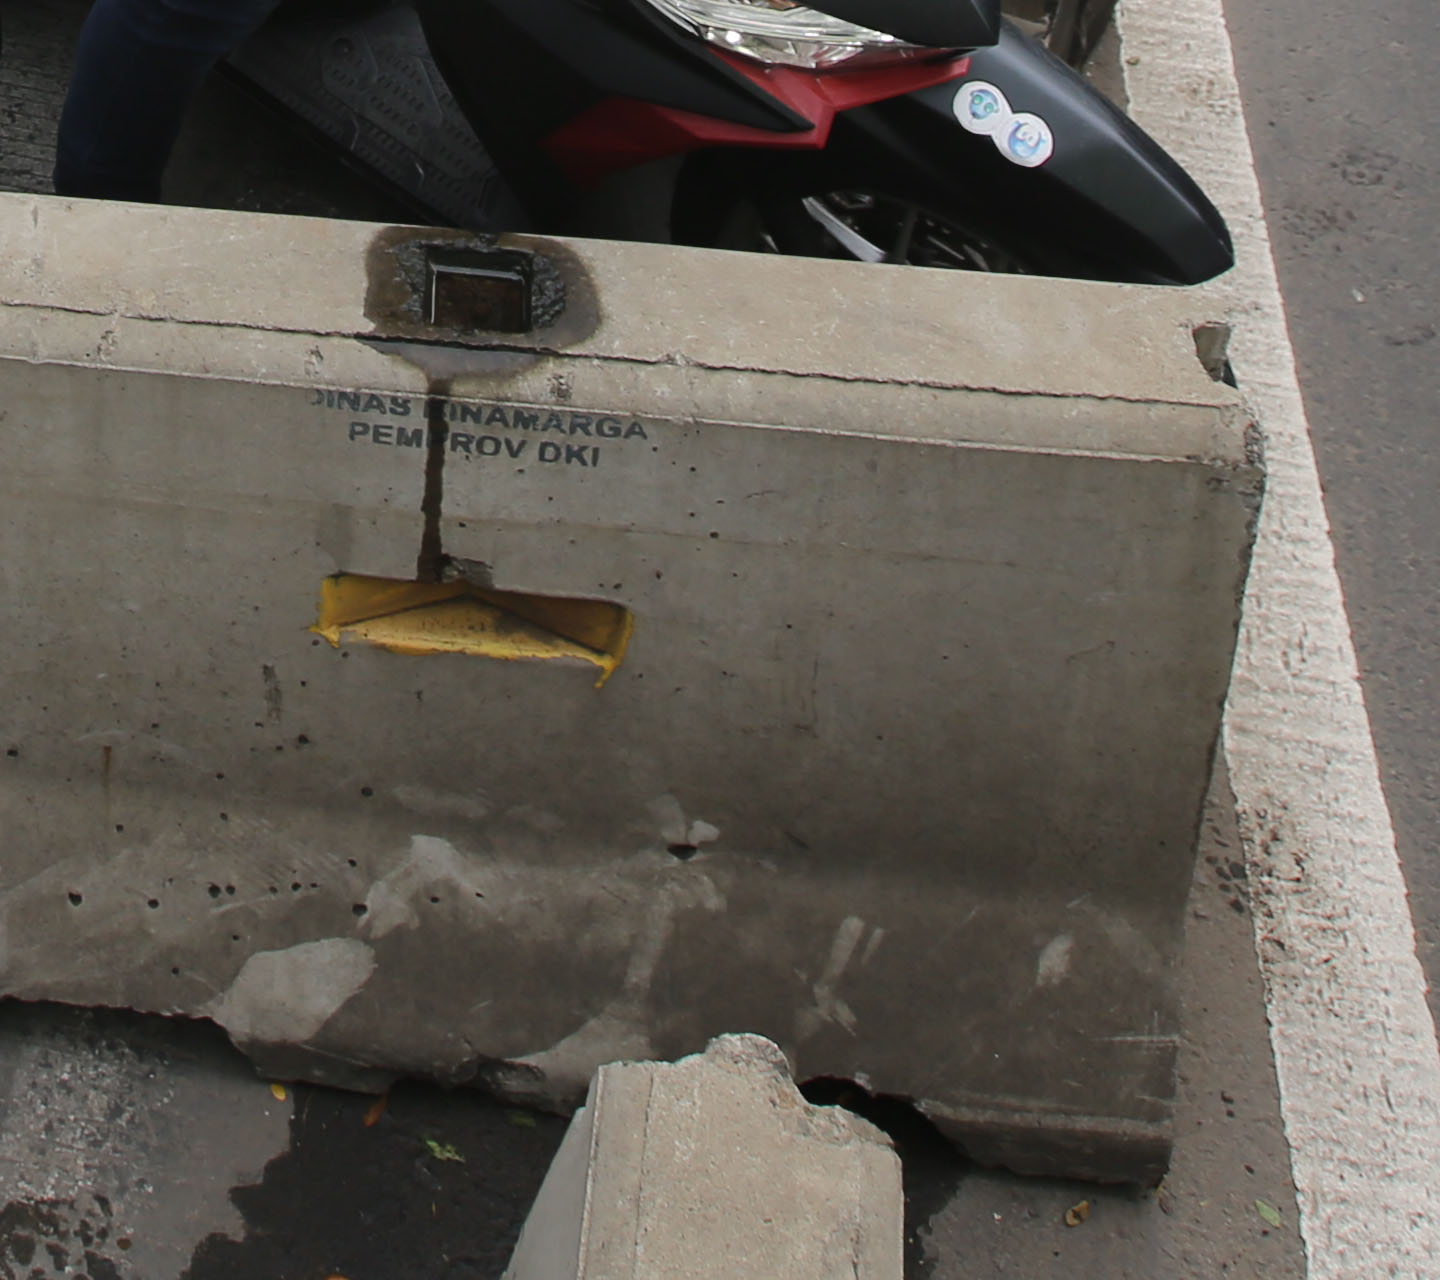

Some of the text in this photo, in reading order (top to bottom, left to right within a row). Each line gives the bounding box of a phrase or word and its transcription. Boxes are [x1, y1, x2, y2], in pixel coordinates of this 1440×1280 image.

[424, 401, 648, 440] INAMARGA
[349, 420, 600, 468] PEMROV DKI
